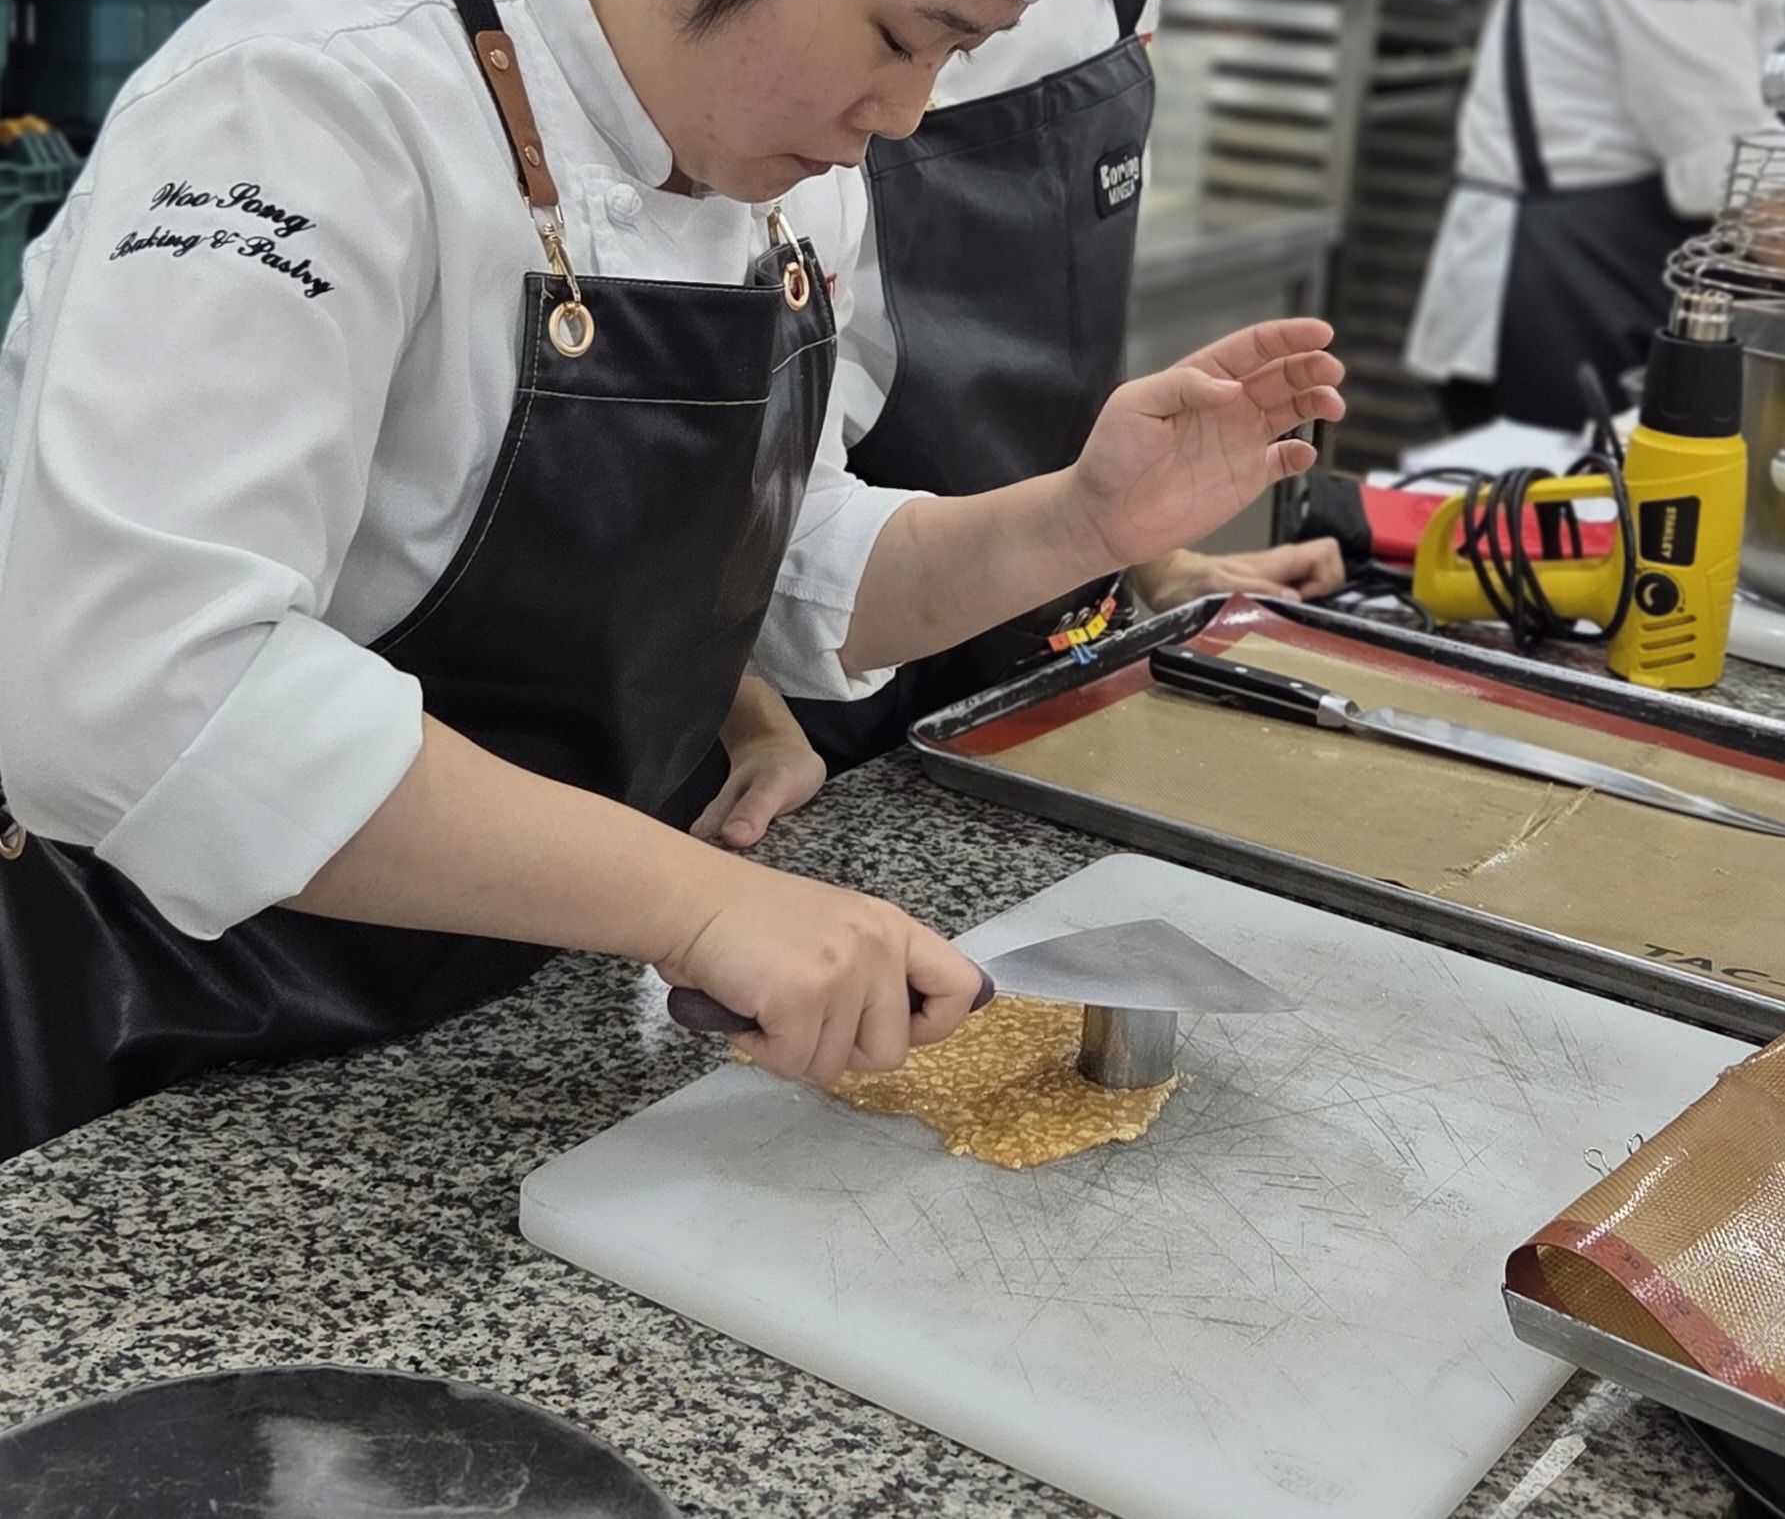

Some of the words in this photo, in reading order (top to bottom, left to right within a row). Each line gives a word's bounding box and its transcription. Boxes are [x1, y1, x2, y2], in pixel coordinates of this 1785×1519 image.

[150, 180, 213, 211] Woo
[215, 182, 316, 238] Song
[109, 225, 203, 260] Baking
[209, 229, 242, 249] &
[237, 236, 335, 299] Pastry
[1661, 506, 1677, 559] STANLEY
[1643, 943, 1785, 987] TAC
